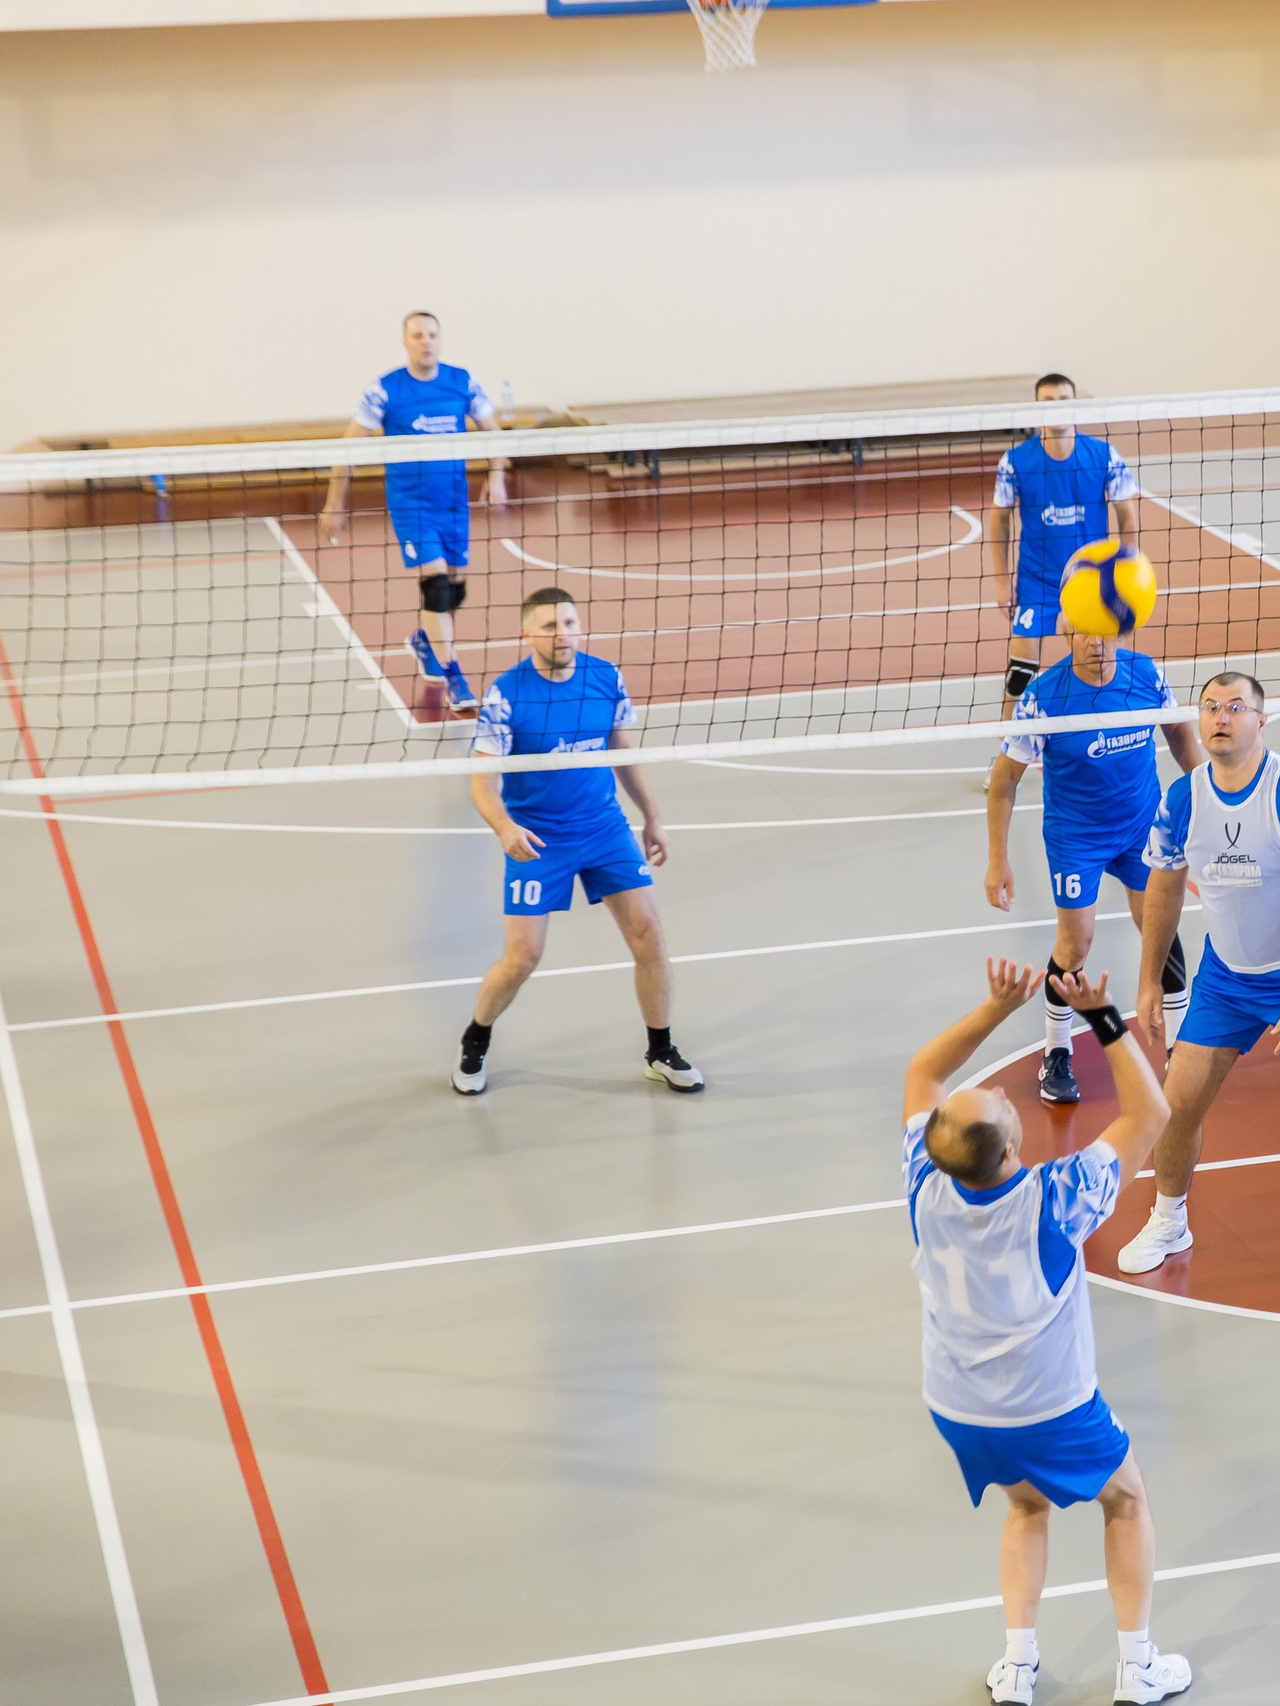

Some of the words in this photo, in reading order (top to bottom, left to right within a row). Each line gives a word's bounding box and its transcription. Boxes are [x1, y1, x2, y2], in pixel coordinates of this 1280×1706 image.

[1012, 605, 1035, 629] 14
[1106, 728, 1150, 749] ГАЗПРОМ
[1213, 853, 1257, 864] JÖGEL
[509, 879, 542, 906] 10
[1053, 872, 1082, 899] 16
[931, 1244, 1042, 1319] 11
